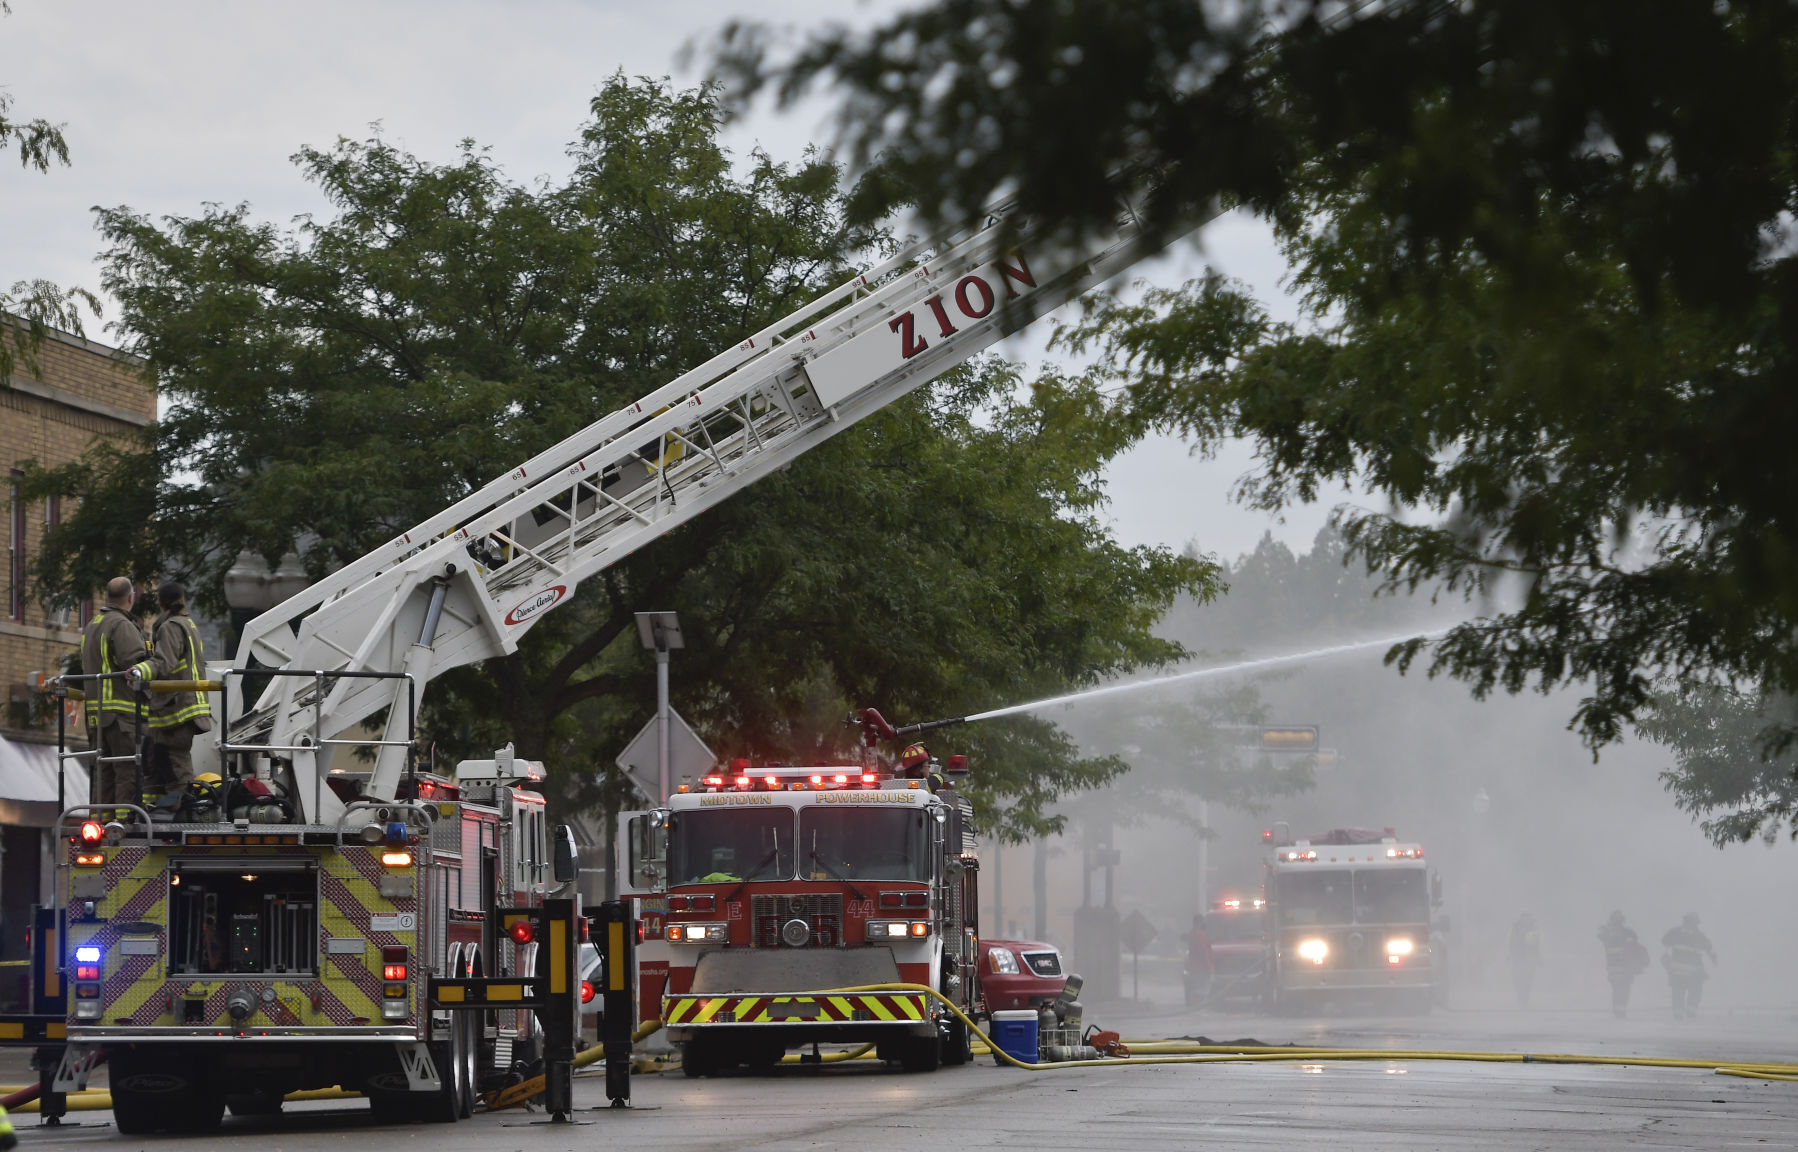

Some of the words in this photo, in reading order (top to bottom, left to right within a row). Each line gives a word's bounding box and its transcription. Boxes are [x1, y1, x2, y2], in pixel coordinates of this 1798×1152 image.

[914, 270, 924, 279] 95
[851, 279, 861, 288] 95
[888, 248, 1037, 359] ZION
[801, 334, 811, 344] 85
[686, 400, 696, 408] 75
[626, 407, 636, 416] 75
[569, 466, 580, 475] 65
[512, 471, 522, 481] 65
[516, 605, 537, 621] Pierce
[700, 793, 772, 807] MIDTOWN
[815, 792, 916, 804] POWERHOUSE
[640, 898, 665, 911] NGIN
[727, 901, 742, 921] E
[847, 899, 875, 918] 44
